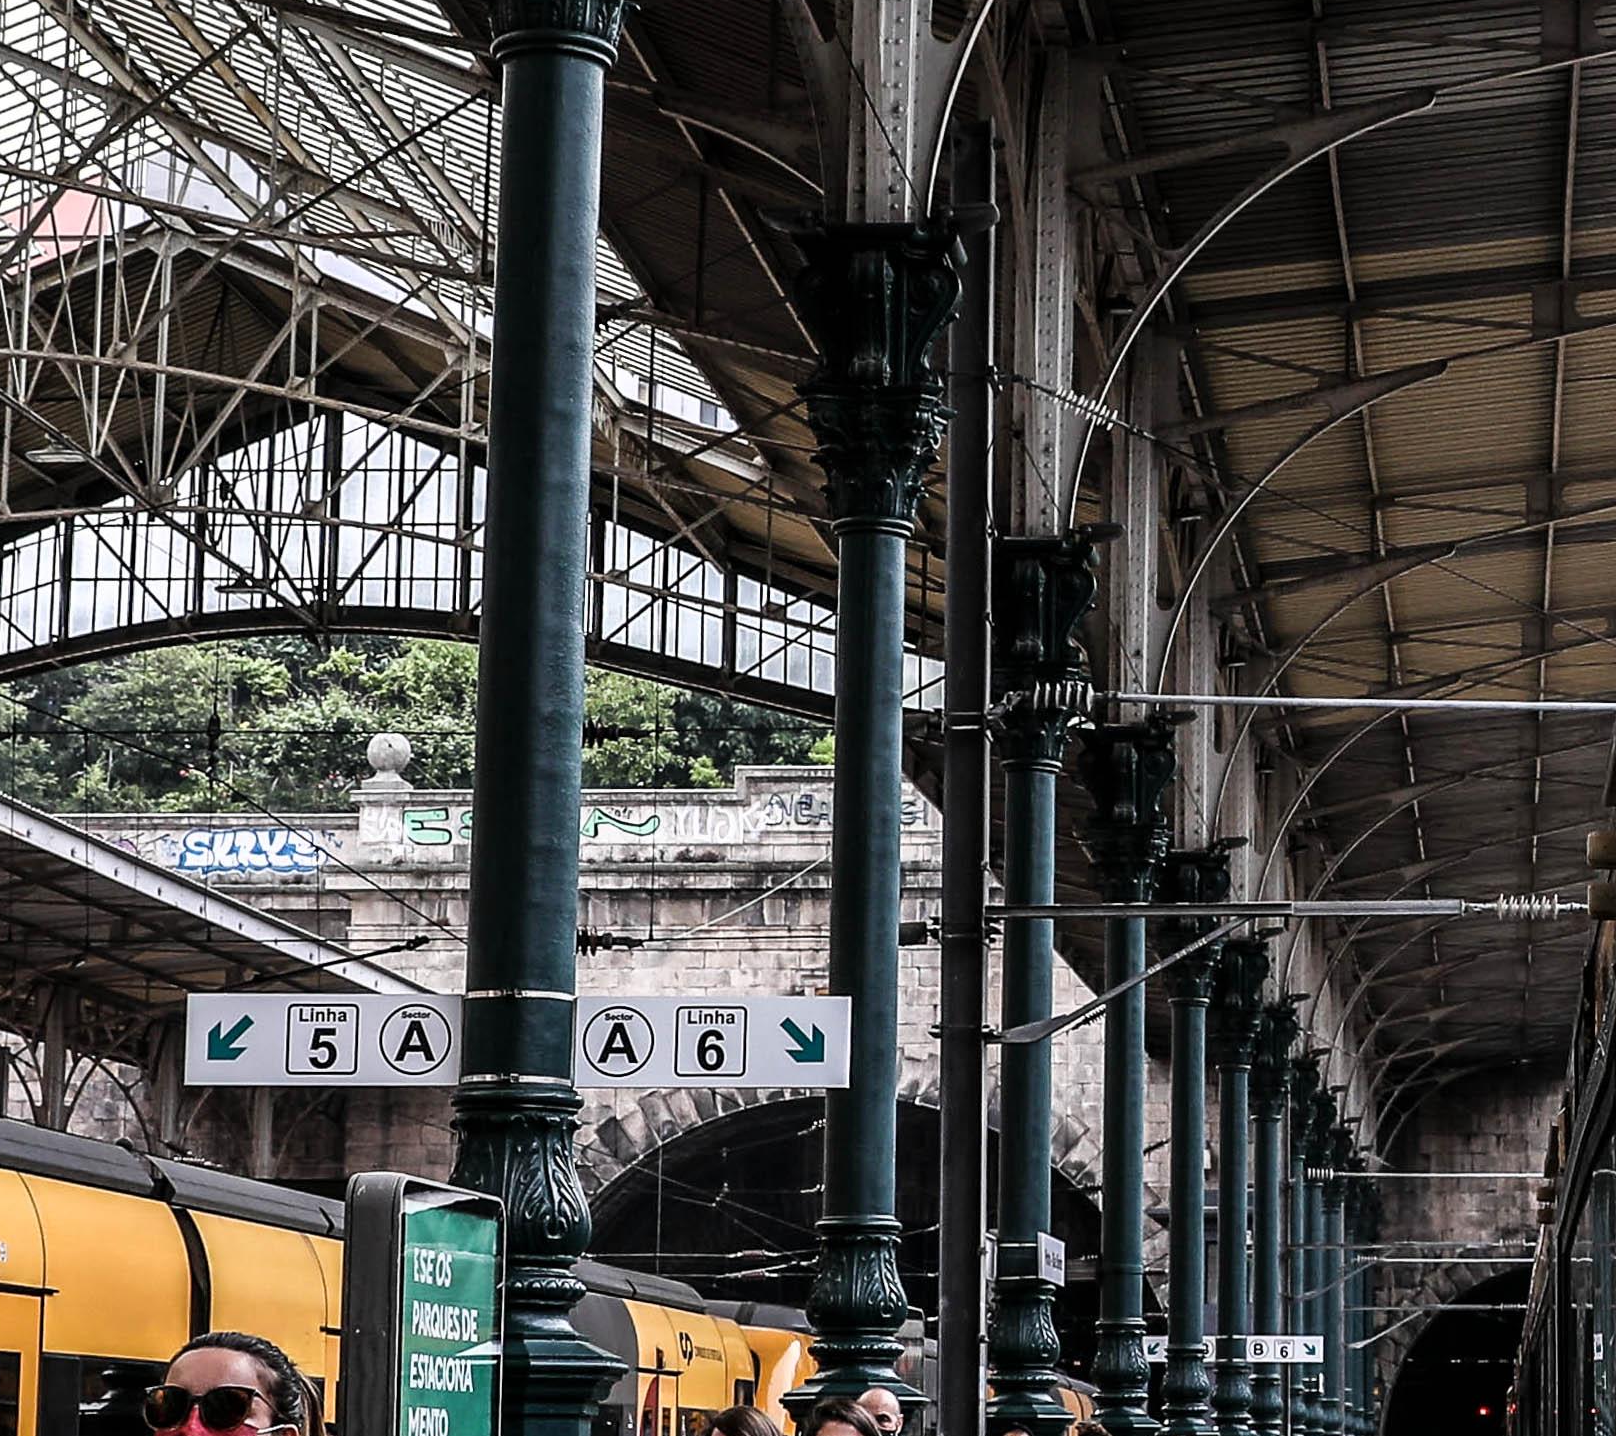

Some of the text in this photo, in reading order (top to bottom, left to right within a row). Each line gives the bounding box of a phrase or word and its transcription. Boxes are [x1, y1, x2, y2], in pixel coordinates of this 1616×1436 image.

[299, 1008, 347, 1022] Linha
[402, 1010, 431, 1019] Sector
[604, 1013, 634, 1022] Sector
[687, 1010, 735, 1024] Linha
[309, 1027, 338, 1069] 5
[394, 1020, 436, 1062] A
[597, 1022, 639, 1064] A
[697, 1029, 725, 1071] 6
[436, 1252, 452, 1288] OS
[412, 1300, 478, 1342] PARQUES DE
[1253, 1343, 1264, 1356] B
[1279, 1345, 1289, 1359] 6
[410, 1353, 474, 1392] ESTACIONA
